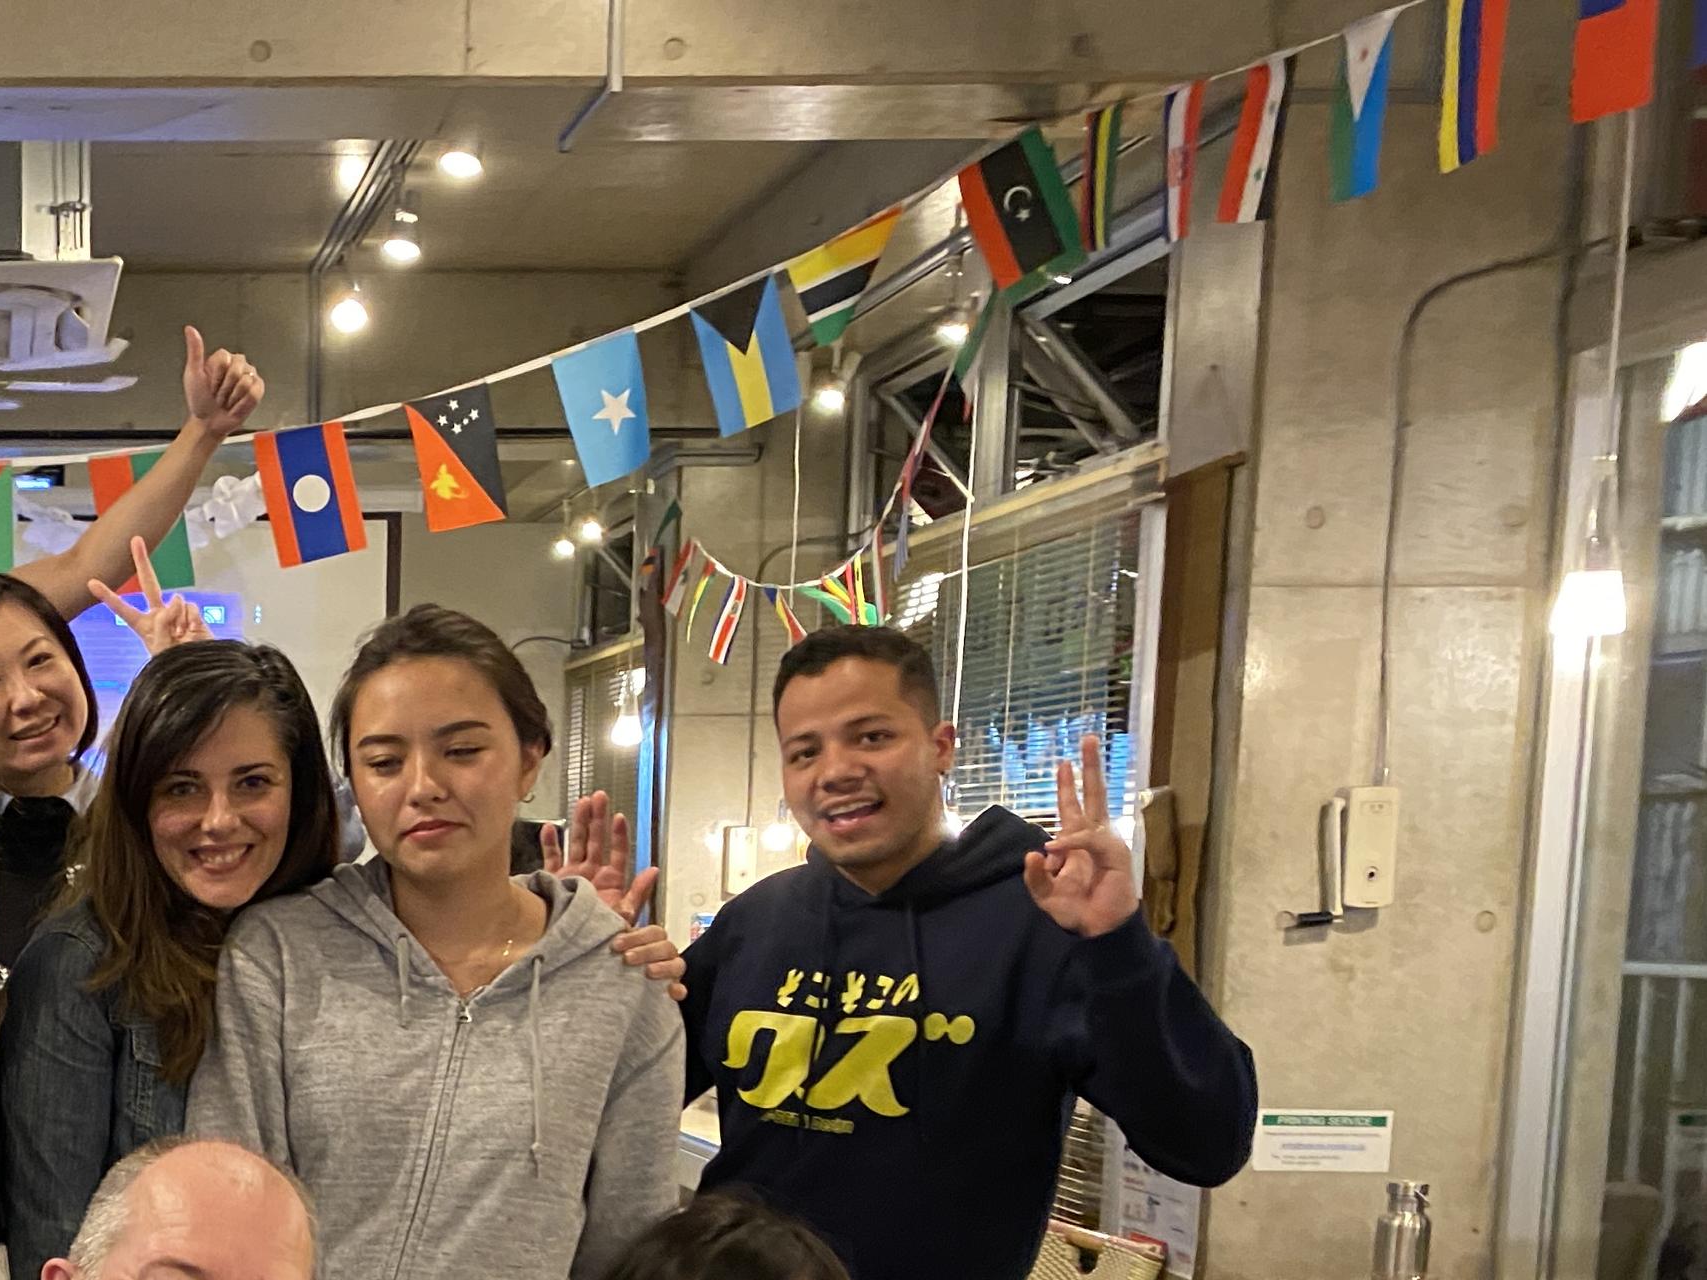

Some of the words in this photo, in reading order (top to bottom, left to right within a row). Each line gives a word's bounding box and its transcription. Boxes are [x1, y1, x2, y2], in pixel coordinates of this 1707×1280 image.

[776, 968, 921, 1015] そこそこの
[721, 1010, 976, 1117] クズ
[1276, 1115, 1326, 1126] PRINTING
[1327, 1116, 1372, 1127] SERVICE
